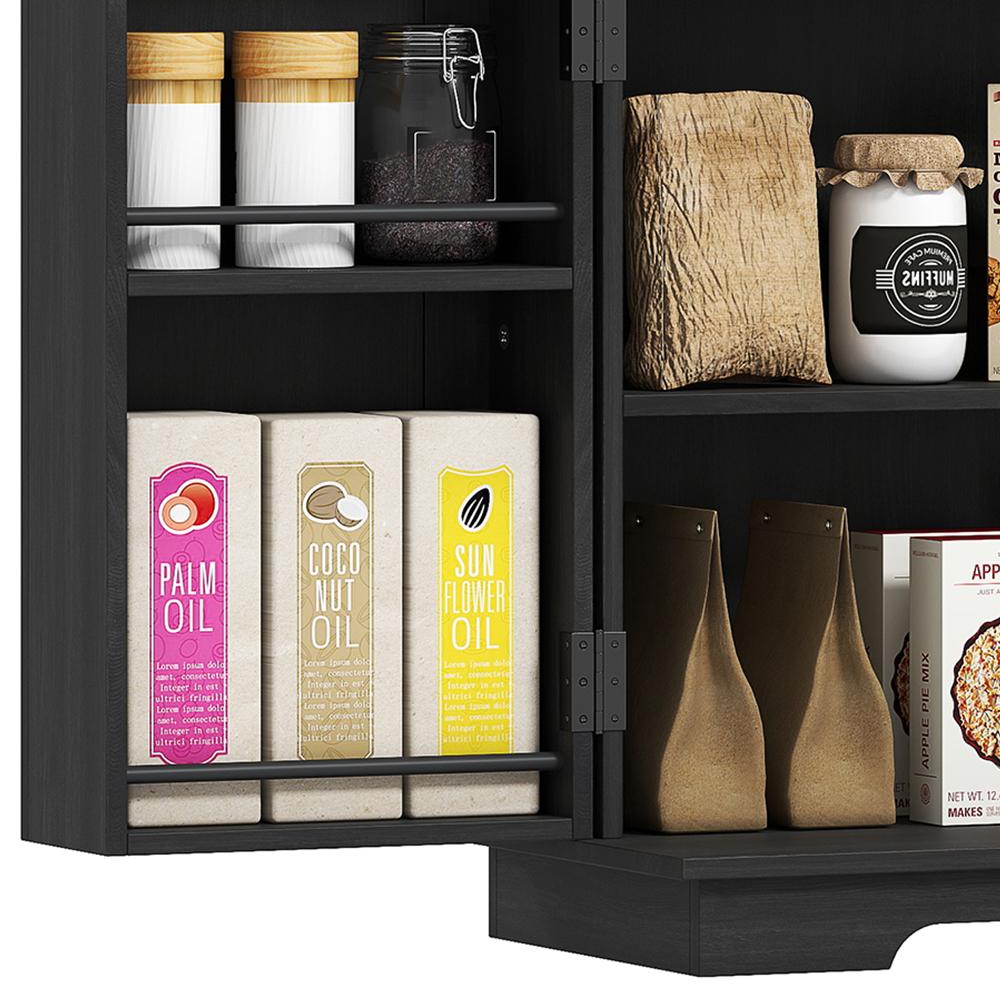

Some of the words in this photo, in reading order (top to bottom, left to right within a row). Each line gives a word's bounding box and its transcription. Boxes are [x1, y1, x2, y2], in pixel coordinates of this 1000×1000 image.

[309, 542, 361, 576] COCO
[455, 544, 495, 578] SUN
[160, 562, 216, 597] PALM
[315, 579, 355, 612] NUT
[444, 580, 505, 614] FLOWER
[164, 598, 214, 633] OIL
[311, 615, 360, 649] OIL
[451, 616, 500, 651] OIL
[921, 652, 929, 682] MIX
[921, 688, 929, 713] PIE
[921, 718, 929, 769] APPLE
[948, 791, 966, 802] NET
[967, 791, 984, 802] WT.
[948, 807, 983, 818] MAKES
